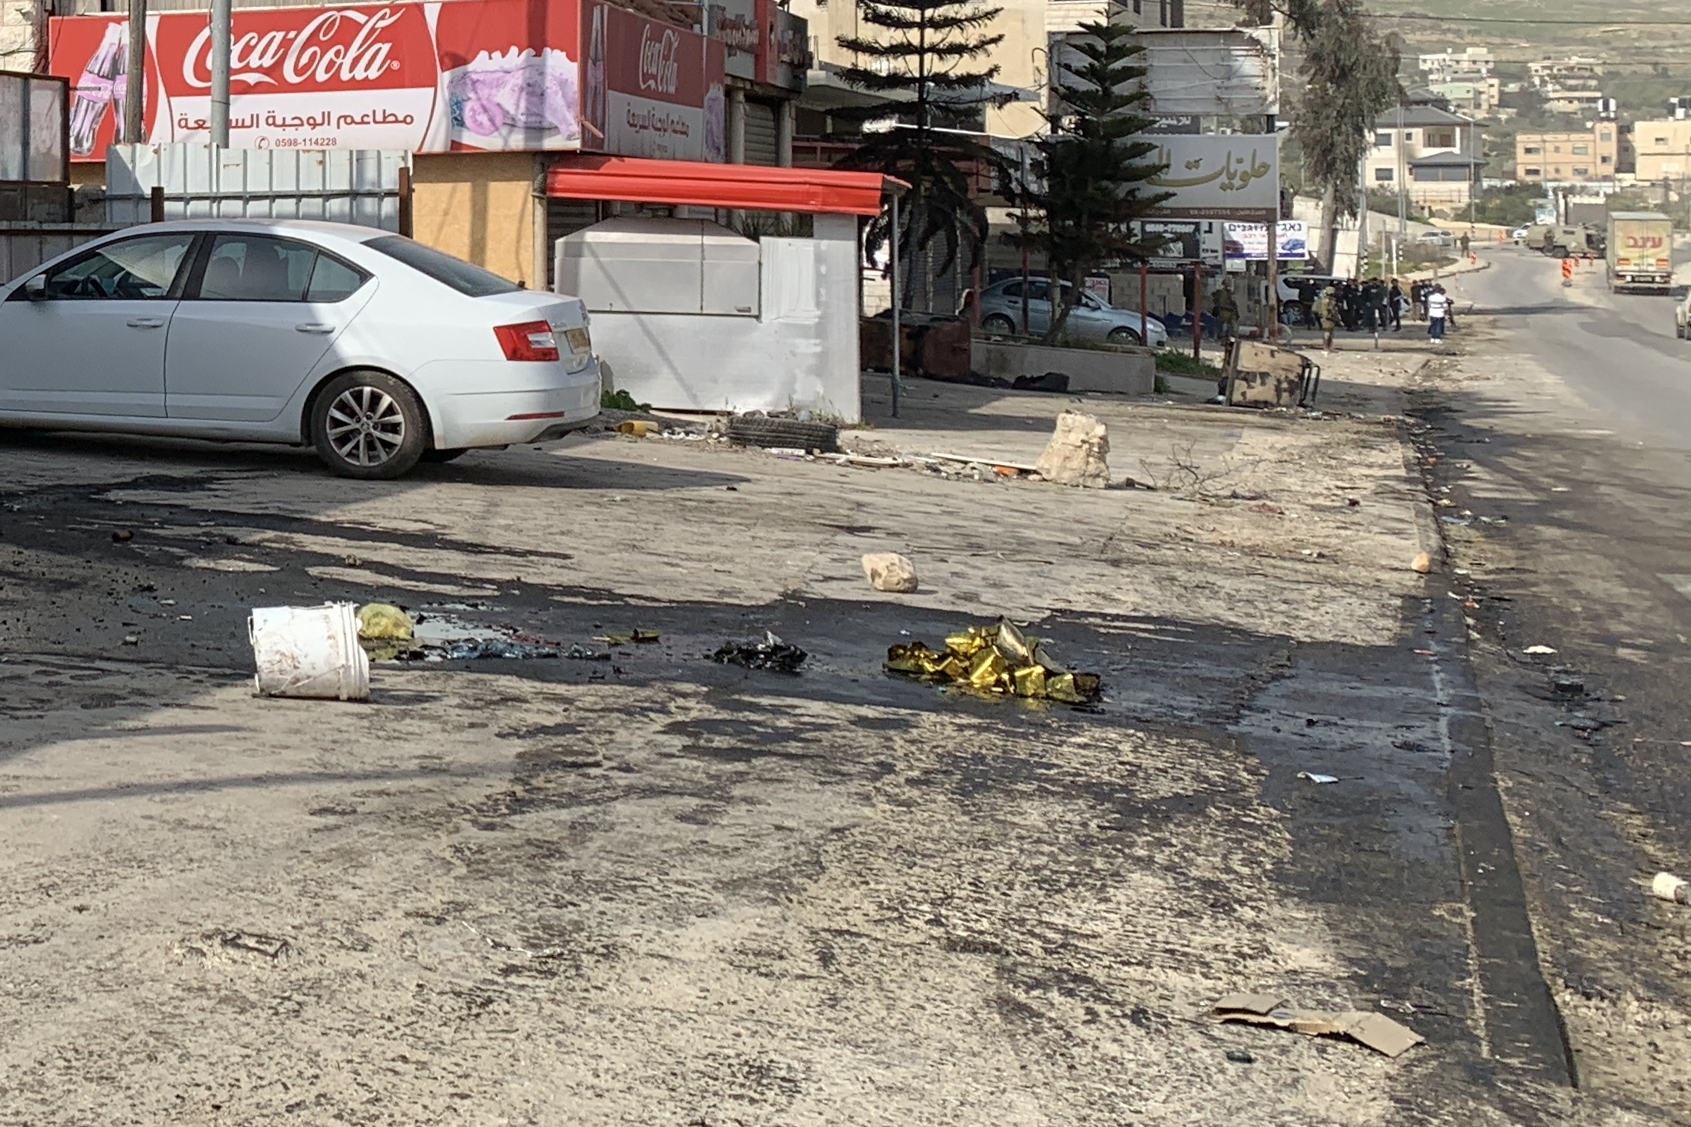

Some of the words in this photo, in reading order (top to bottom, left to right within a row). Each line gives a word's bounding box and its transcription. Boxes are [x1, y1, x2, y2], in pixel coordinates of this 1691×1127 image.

[182, 7, 406, 88] Cca-Cola
[177, 112, 259, 134] السعة
[265, 110, 332, 132] الوجبة
[336, 109, 414, 130] مطاعم
[275, 137, 338, 147] 0598-114228
